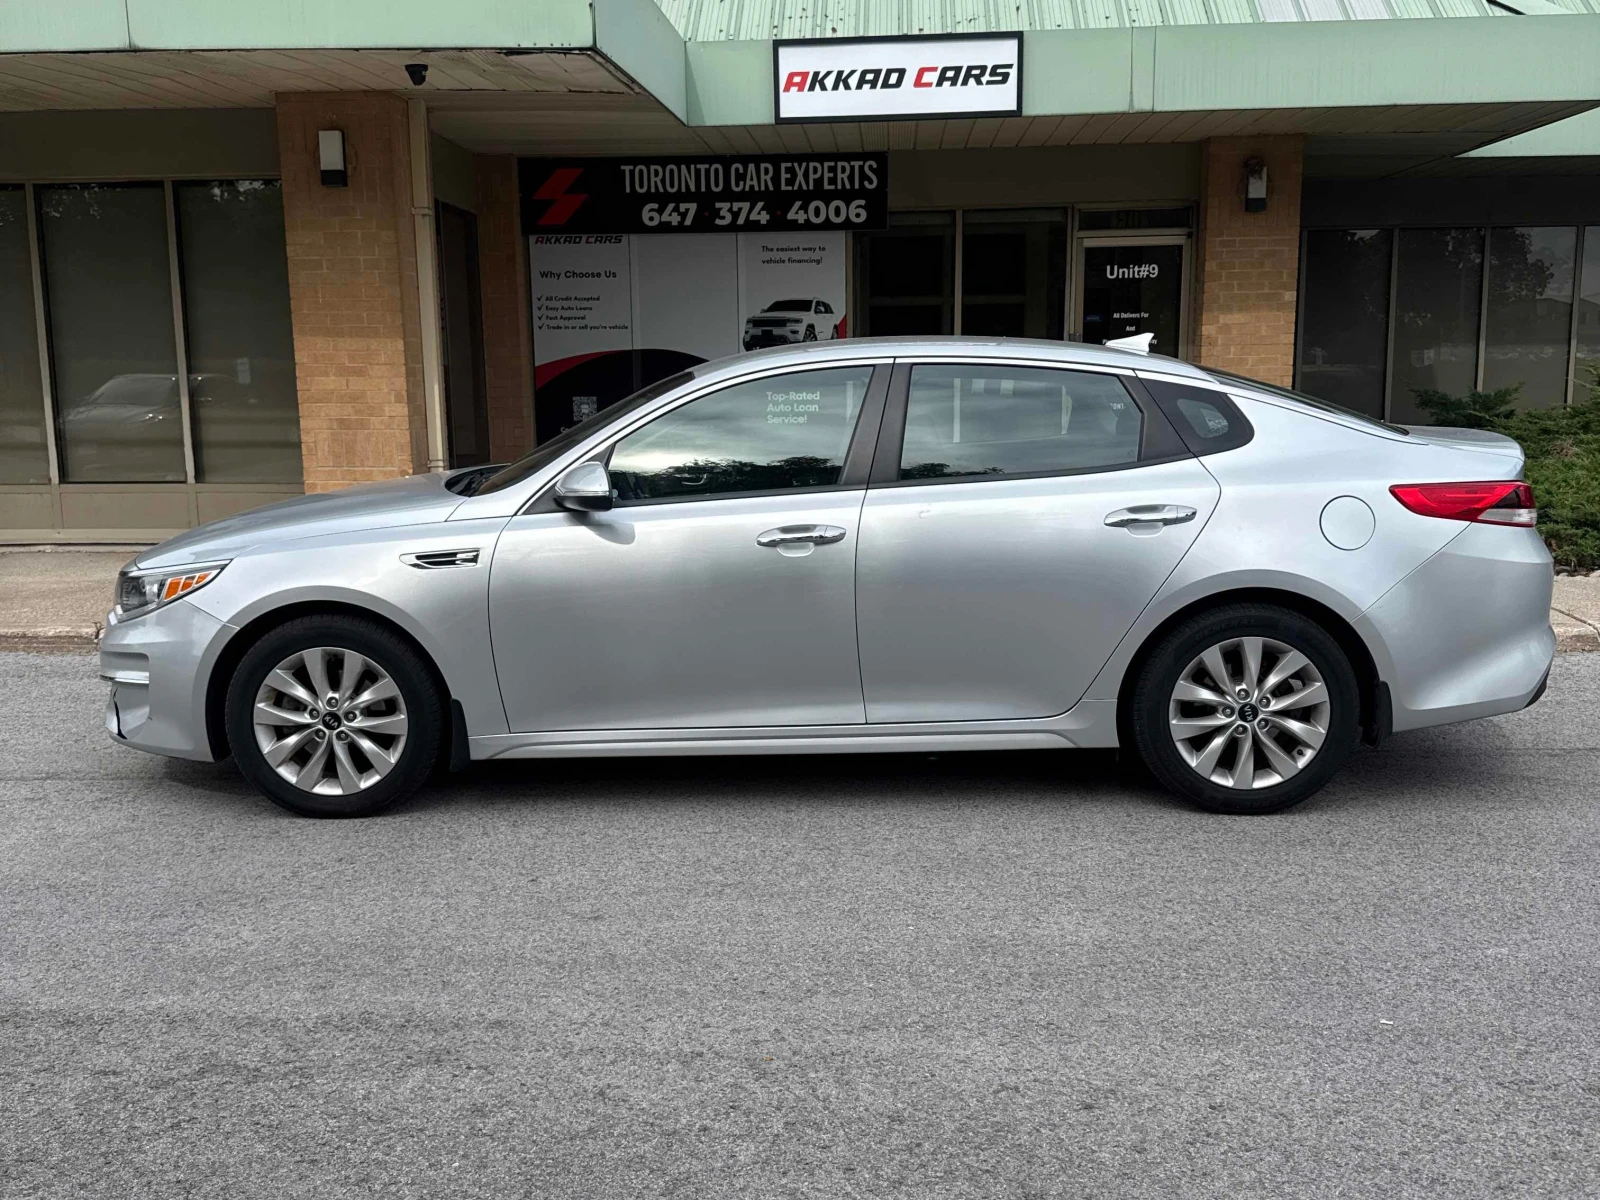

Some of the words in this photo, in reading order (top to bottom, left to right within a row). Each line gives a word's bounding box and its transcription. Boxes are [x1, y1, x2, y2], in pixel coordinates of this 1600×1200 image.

[783, 67, 907, 92] AKKAD
[913, 63, 1014, 88] CARS
[621, 164, 724, 193] TORONTO
[730, 162, 774, 192] CAR
[780, 160, 878, 190] EXPERTS
[641, 202, 698, 227] 647
[714, 201, 770, 226] 374
[786, 199, 868, 224] 4006
[535, 236, 583, 245] AKKAD
[585, 235, 623, 244] CARS
[761, 245, 774, 253] The
[802, 246, 817, 254] way
[761, 257, 786, 265] vehicle
[788, 256, 823, 266] financing!
[539, 270, 562, 281] Why
[564, 270, 602, 279] Choose
[604, 270, 617, 279] Us
[1106, 264, 1159, 279] Unit#9
[573, 295, 601, 303] Accepted
[559, 314, 586, 322] Approval
[766, 391, 820, 402] Top-Rated
[766, 403, 792, 412] Auto
[794, 403, 819, 412] Loan
[767, 414, 807, 424] Service!
[1244, 704, 1253, 721] KIA
[324, 715, 338, 728] KIA
